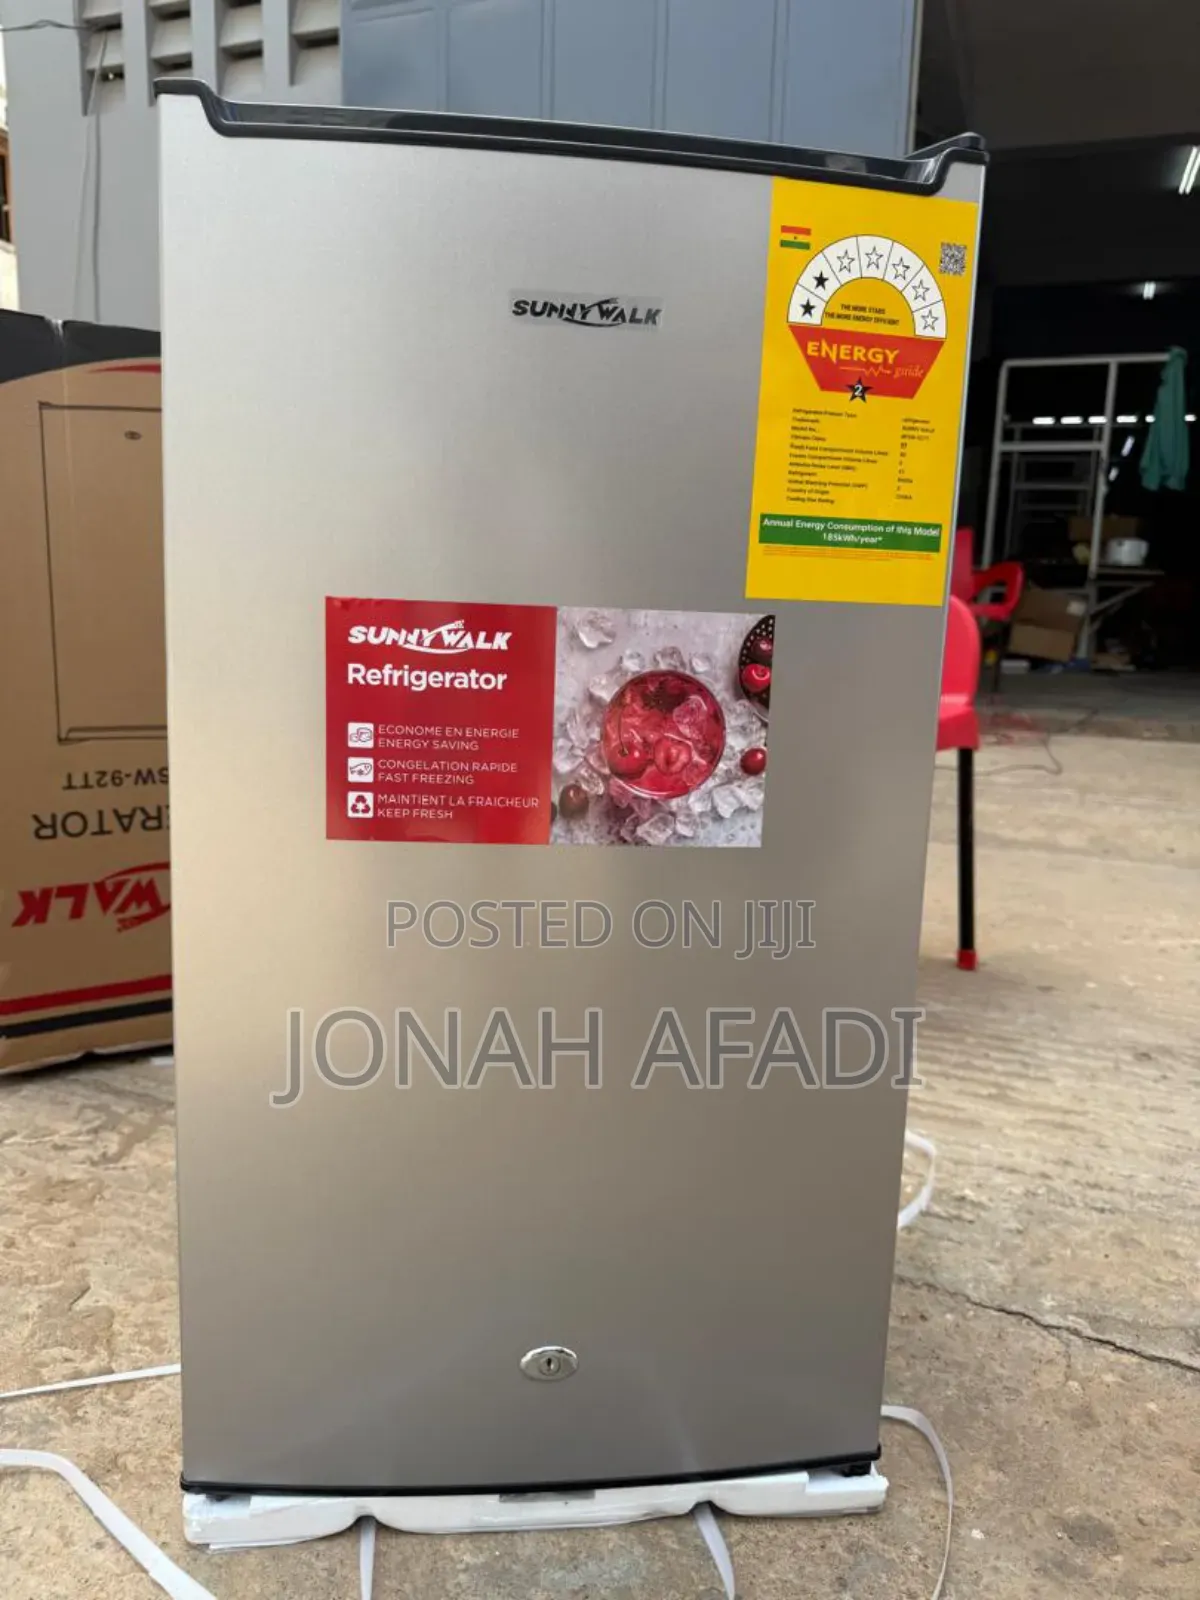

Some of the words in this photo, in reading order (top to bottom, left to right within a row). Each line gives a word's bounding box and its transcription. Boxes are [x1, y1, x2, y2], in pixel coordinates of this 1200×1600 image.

[893, 365, 924, 378] guide
[854, 385, 863, 396] 2
[762, 518, 793, 527] Annual
[796, 520, 825, 531] Energy
[827, 522, 884, 533] Consumption
[886, 525, 895, 533] of
[896, 526, 912, 535] this
[914, 527, 940, 536] Model
[347, 663, 507, 691] Refrigerator
[378, 725, 443, 737] ECONOME
[445, 727, 462, 737] EN
[465, 728, 519, 739] ENERGIE
[378, 738, 430, 749] ENERGY
[433, 740, 479, 751] SAVING
[377, 760, 471, 772] CONGELATION
[473, 761, 517, 773] RAPIDE
[377, 773, 408, 783] FAST
[412, 774, 474, 785] FREEZING
[377, 794, 446, 806] MAINTIENT
[449, 796, 465, 807] LA
[469, 796, 540, 808] FRAICHEUR
[377, 808, 410, 818] KEEP
[413, 809, 453, 819] FRESH
[31, 804, 169, 840] RATOR
